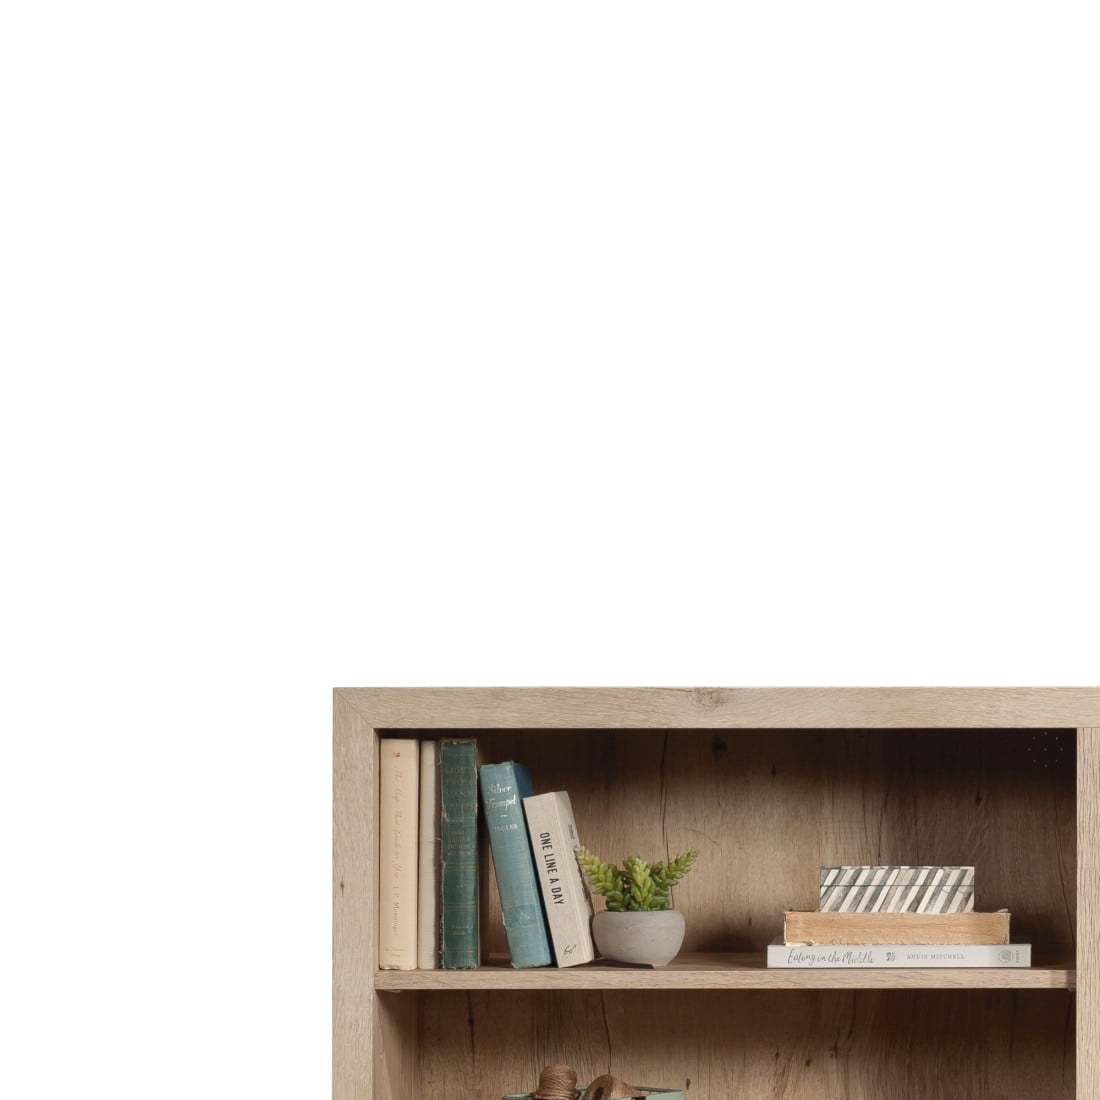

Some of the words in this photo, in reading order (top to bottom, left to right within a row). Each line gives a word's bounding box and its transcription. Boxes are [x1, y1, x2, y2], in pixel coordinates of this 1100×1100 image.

[539, 832, 553, 851] ONE
[544, 853, 558, 874] LINE
[551, 886, 565, 905] DAY
[816, 953, 827, 963] in
[827, 950, 841, 963] the
